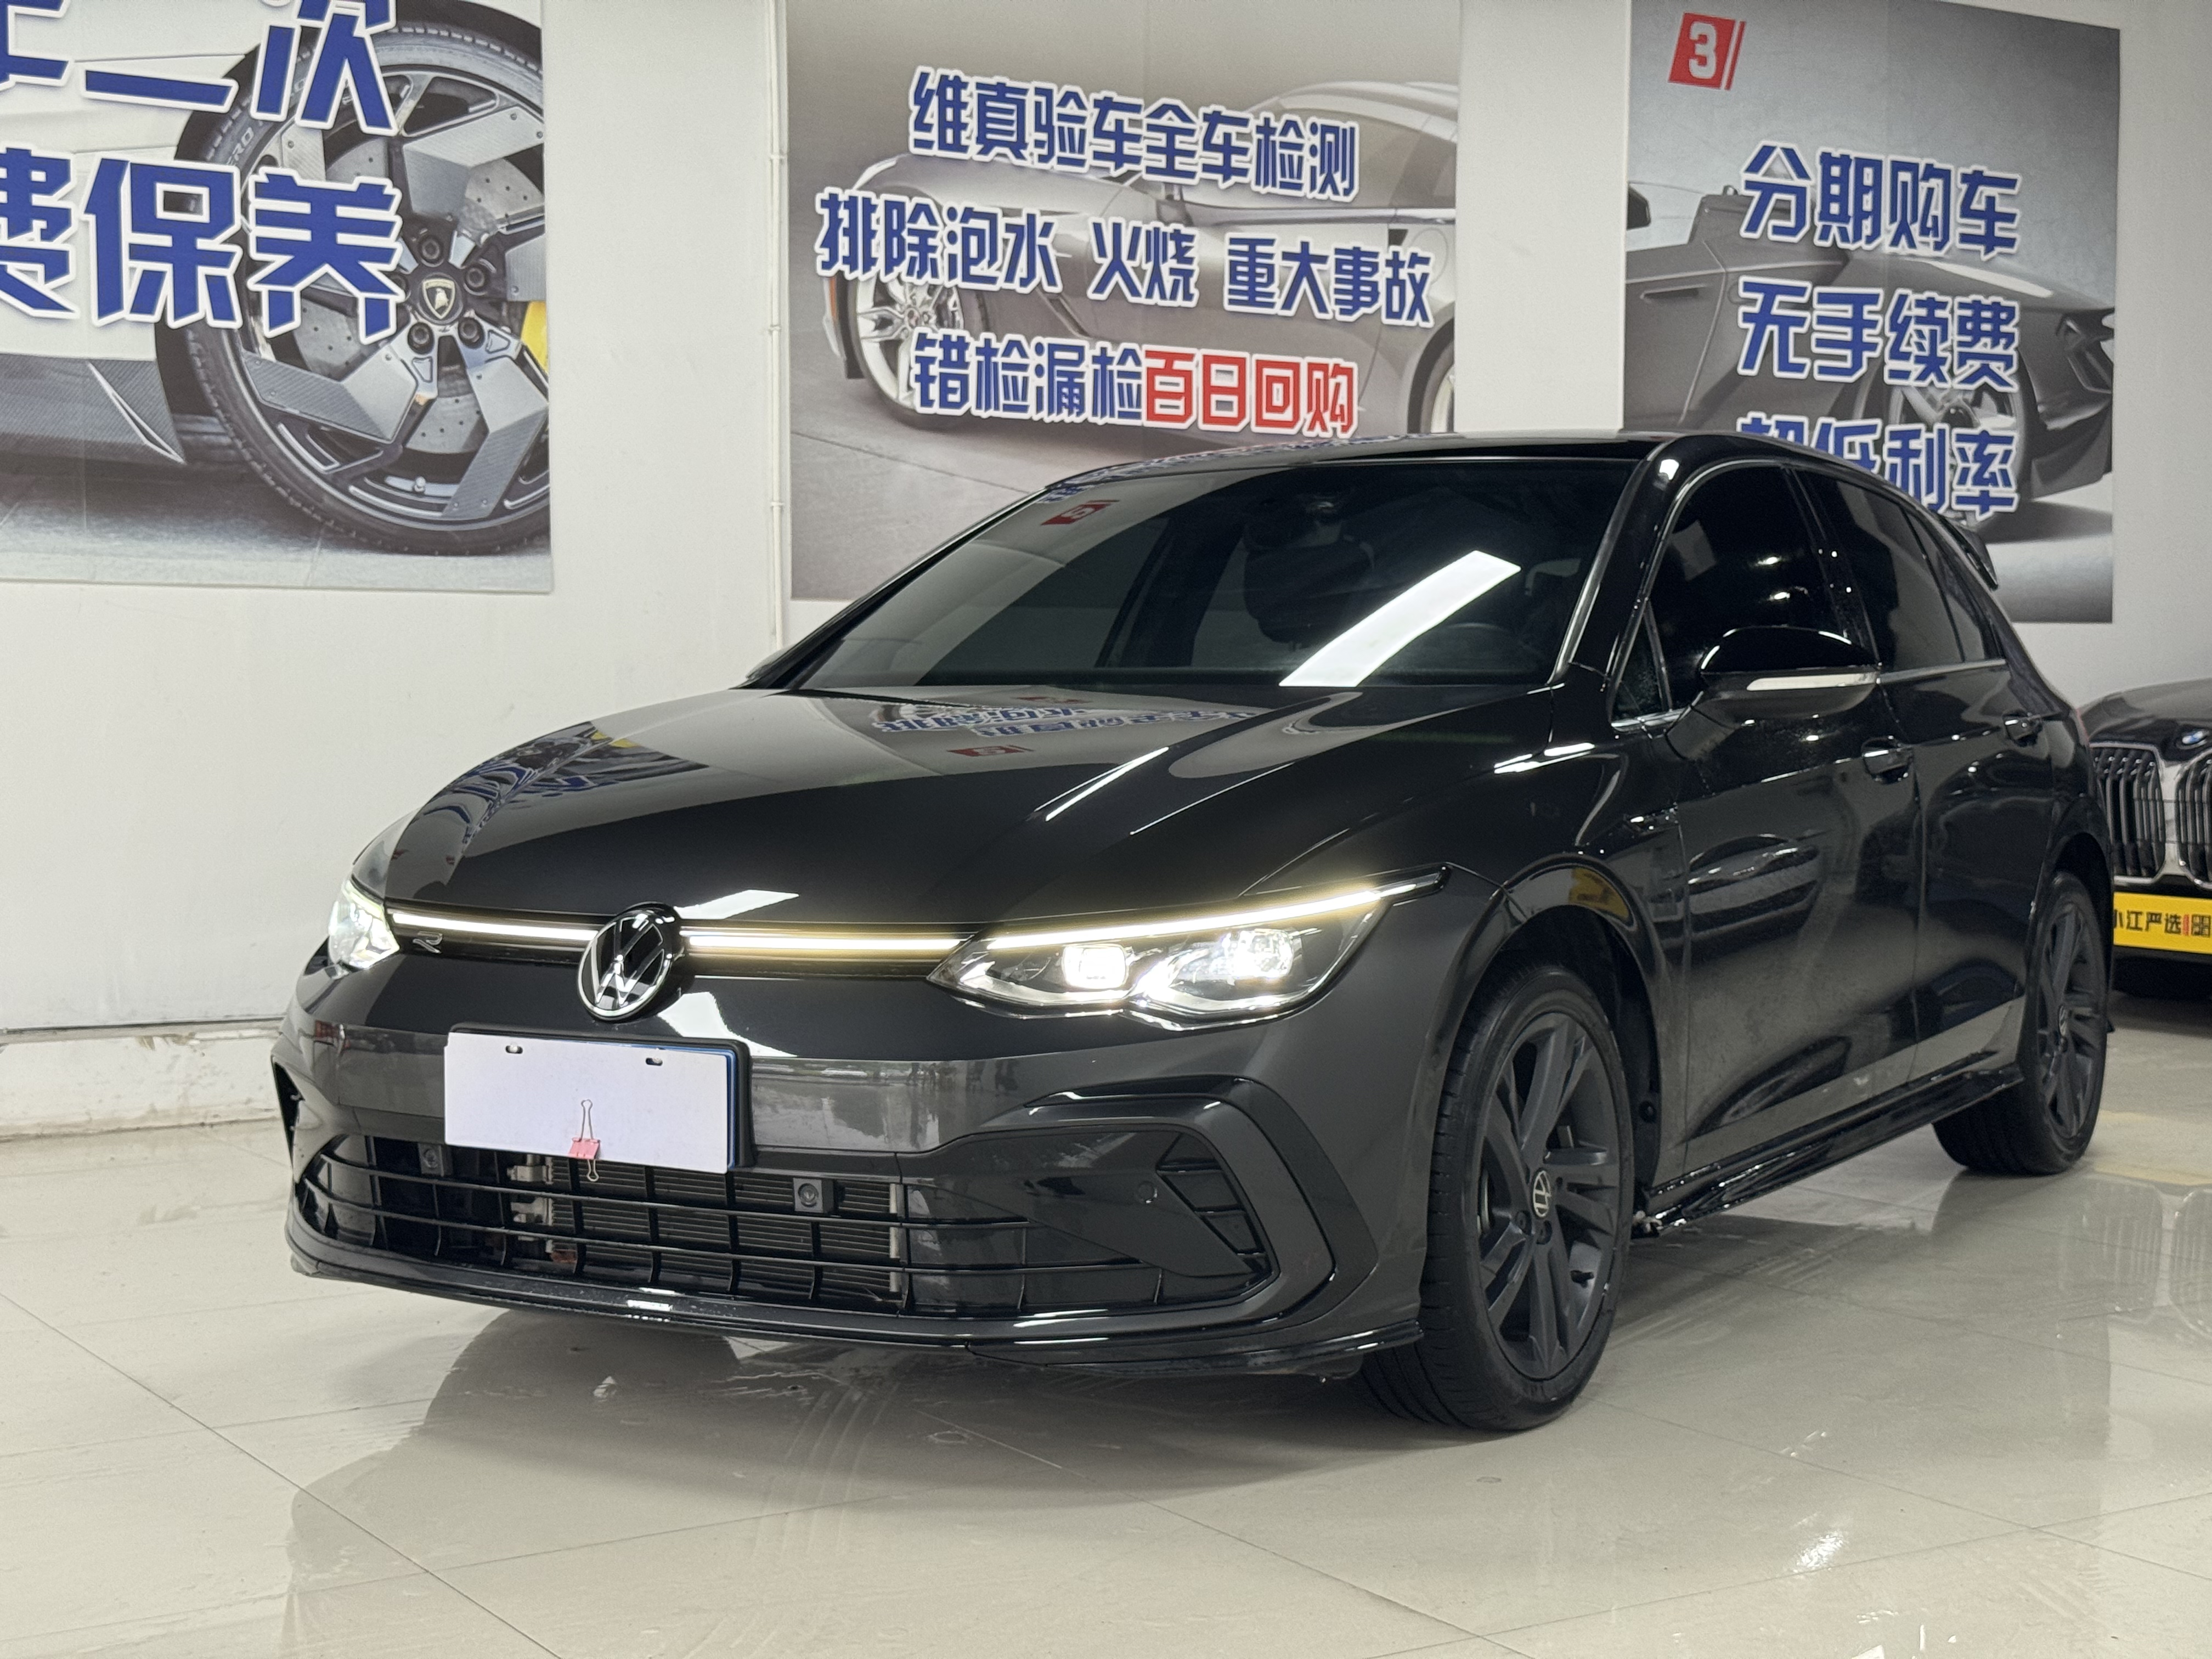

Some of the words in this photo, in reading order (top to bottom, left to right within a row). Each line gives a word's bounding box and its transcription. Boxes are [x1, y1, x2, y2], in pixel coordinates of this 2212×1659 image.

[1689, 21, 1717, 80] 3
[913, 72, 1355, 195] 维真验车全车检测
[1745, 145, 2017, 255] 分期购车
[820, 193, 1057, 289] 排除泡水
[1092, 222, 1195, 303] 火烧
[1229, 237, 1430, 323] 重大事故
[913, 334, 1354, 435] 错检漏检百日回购
[1741, 280, 2017, 391] 无手续费
[1742, 417, 2015, 516] 低利率
